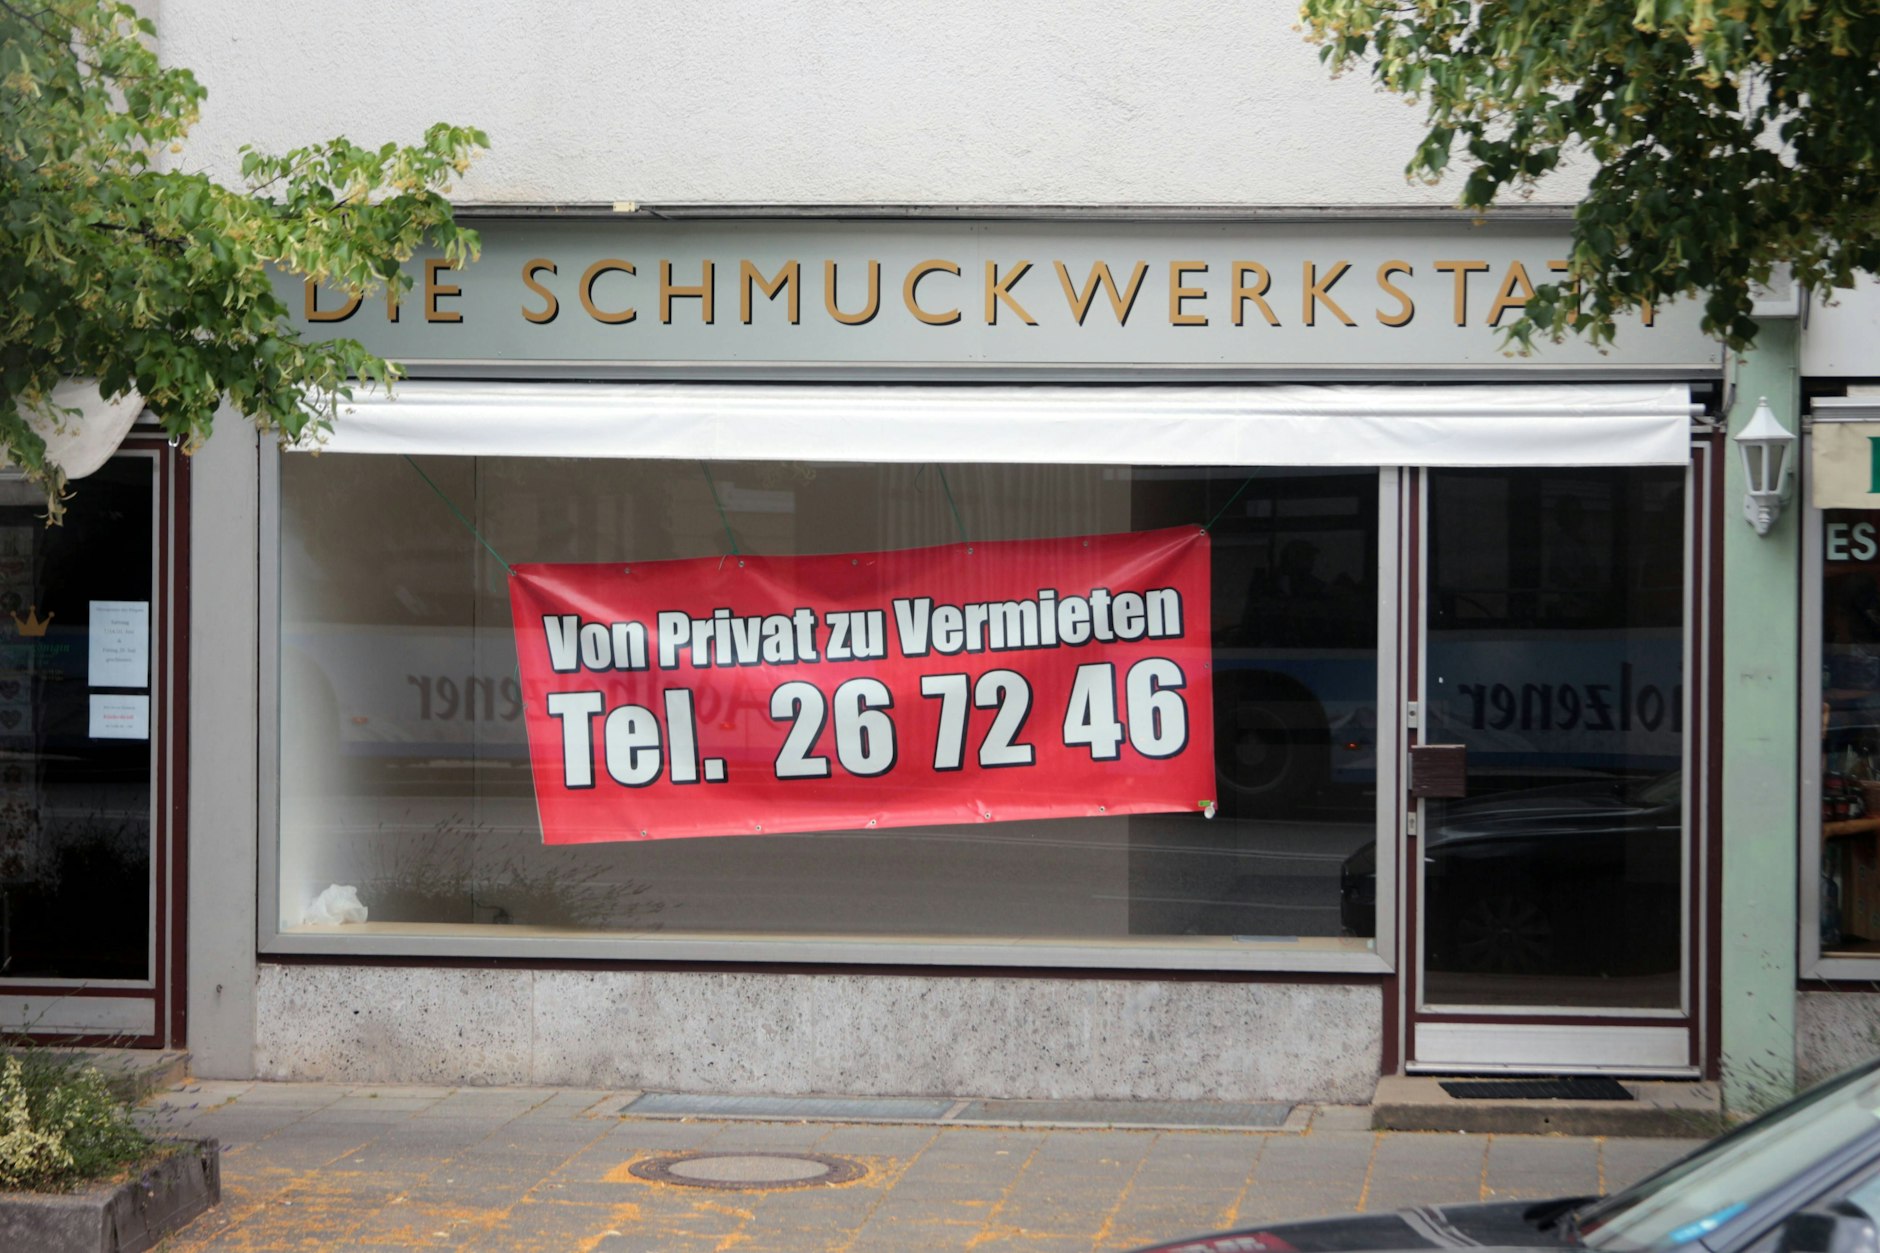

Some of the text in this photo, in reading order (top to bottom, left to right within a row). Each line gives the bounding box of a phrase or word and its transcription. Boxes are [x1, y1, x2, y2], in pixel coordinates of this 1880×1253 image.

[543, 586, 1186, 673] Von Privat zu Vermieten
[546, 657, 1192, 791] Tel. 26 72 46
